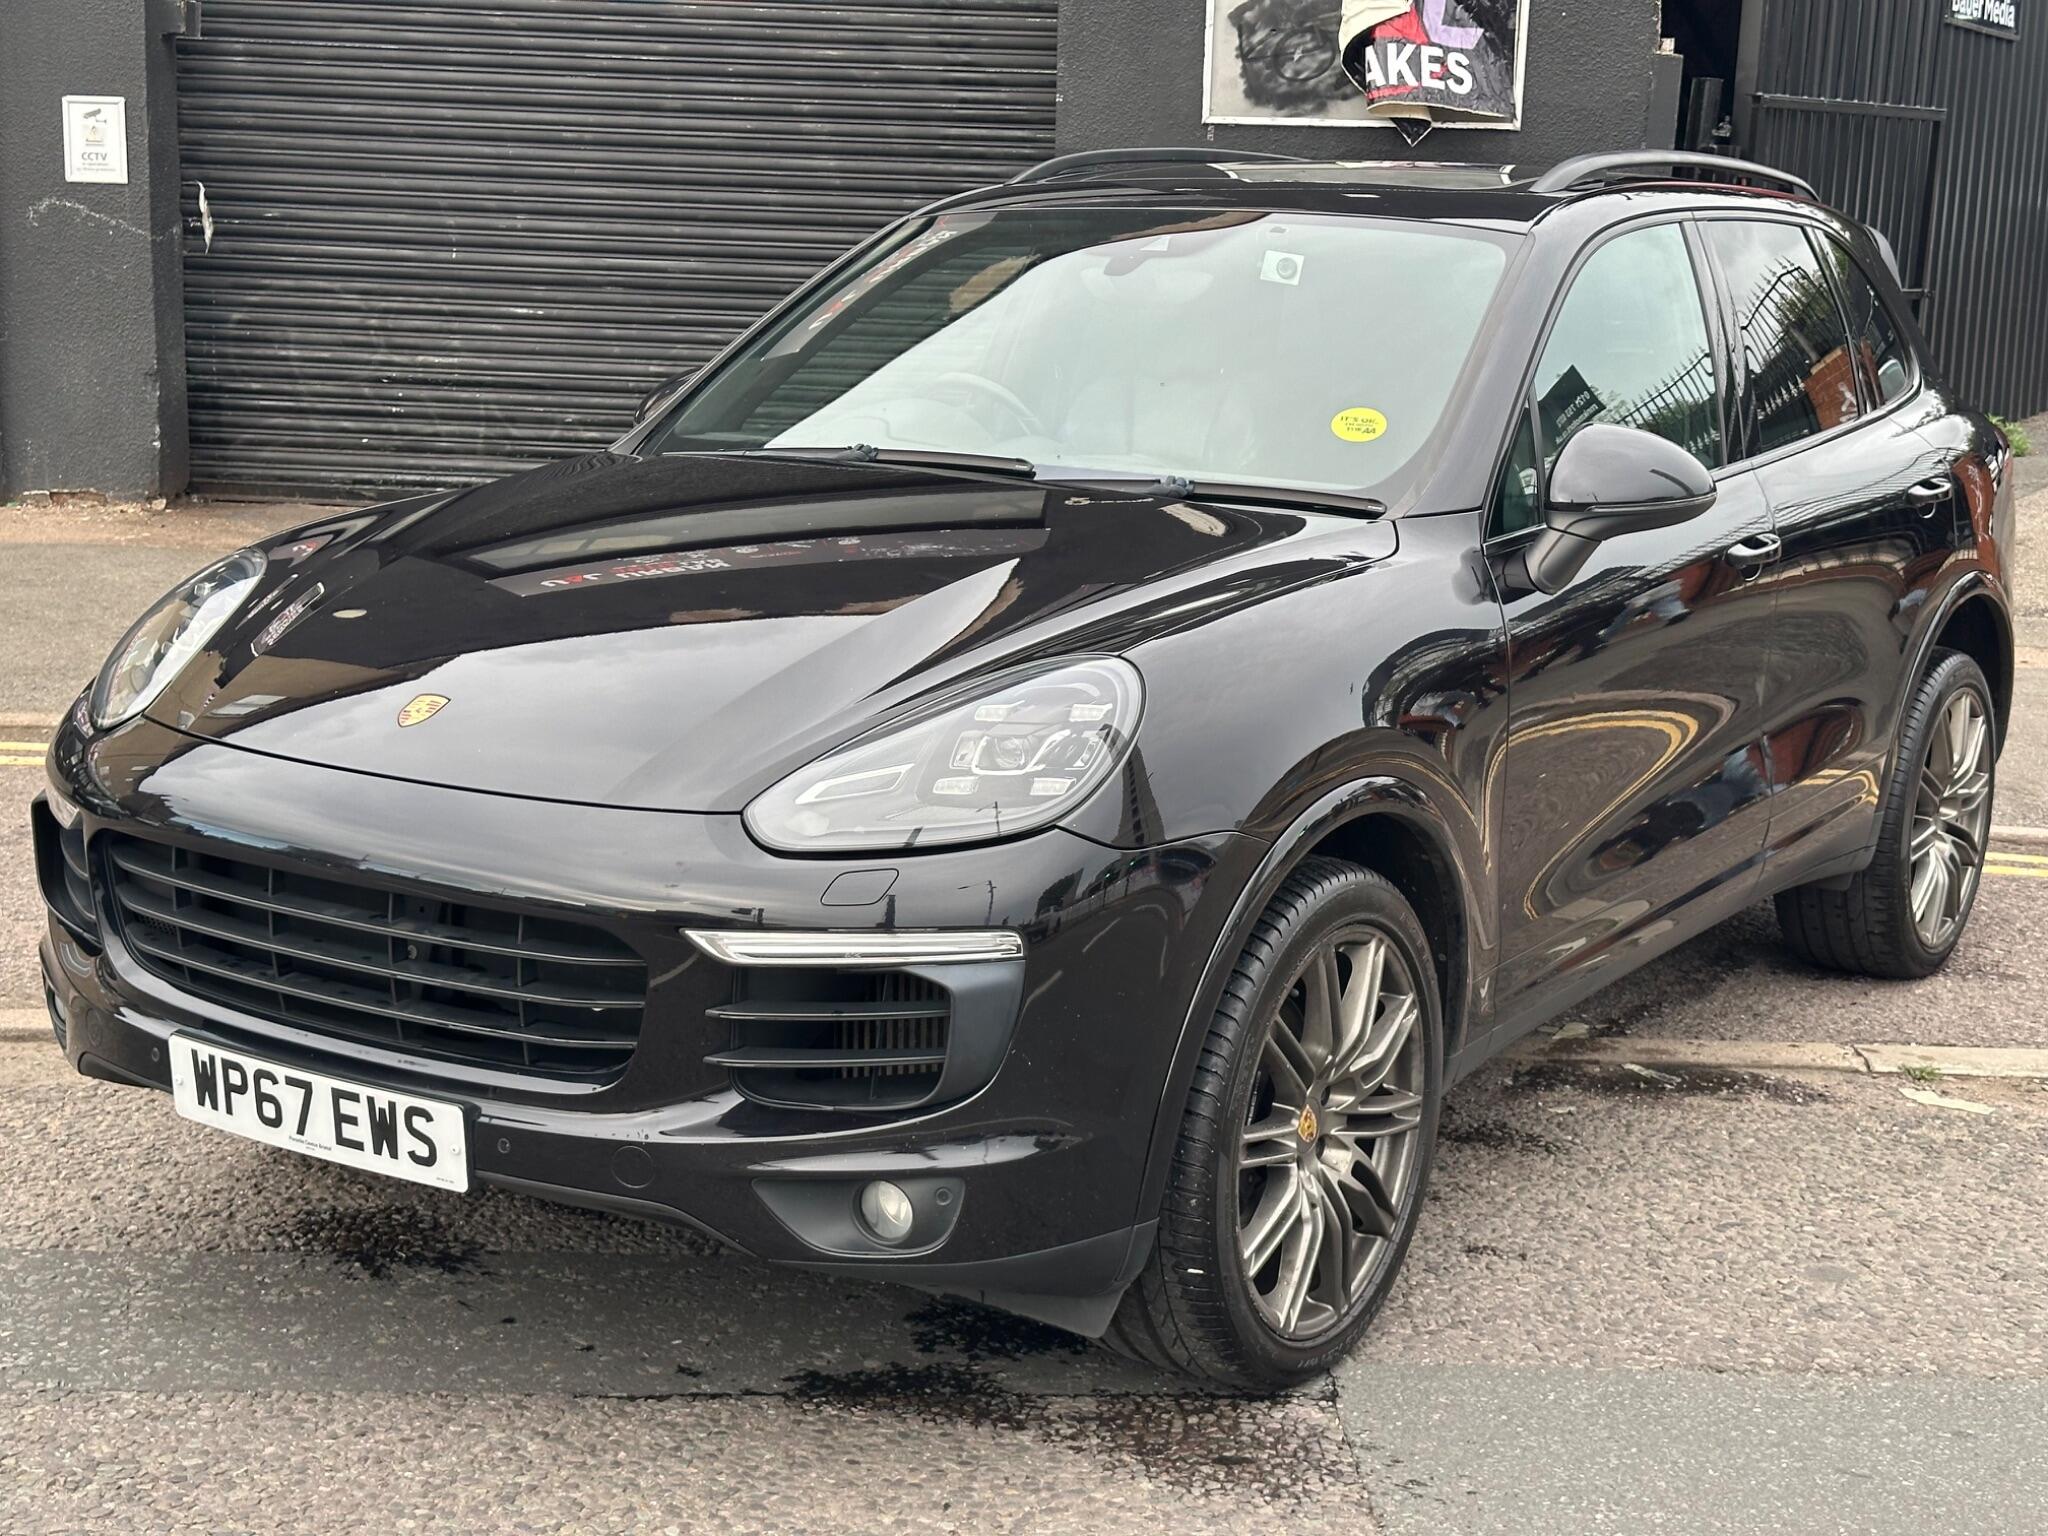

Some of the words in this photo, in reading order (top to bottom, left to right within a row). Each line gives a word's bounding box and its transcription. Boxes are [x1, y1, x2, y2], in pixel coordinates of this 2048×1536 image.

[1984, 0, 2015, 28] Media
[81, 152, 108, 161] CCTV
[191, 1048, 313, 1136] WP67
[330, 1087, 438, 1168] EWS
